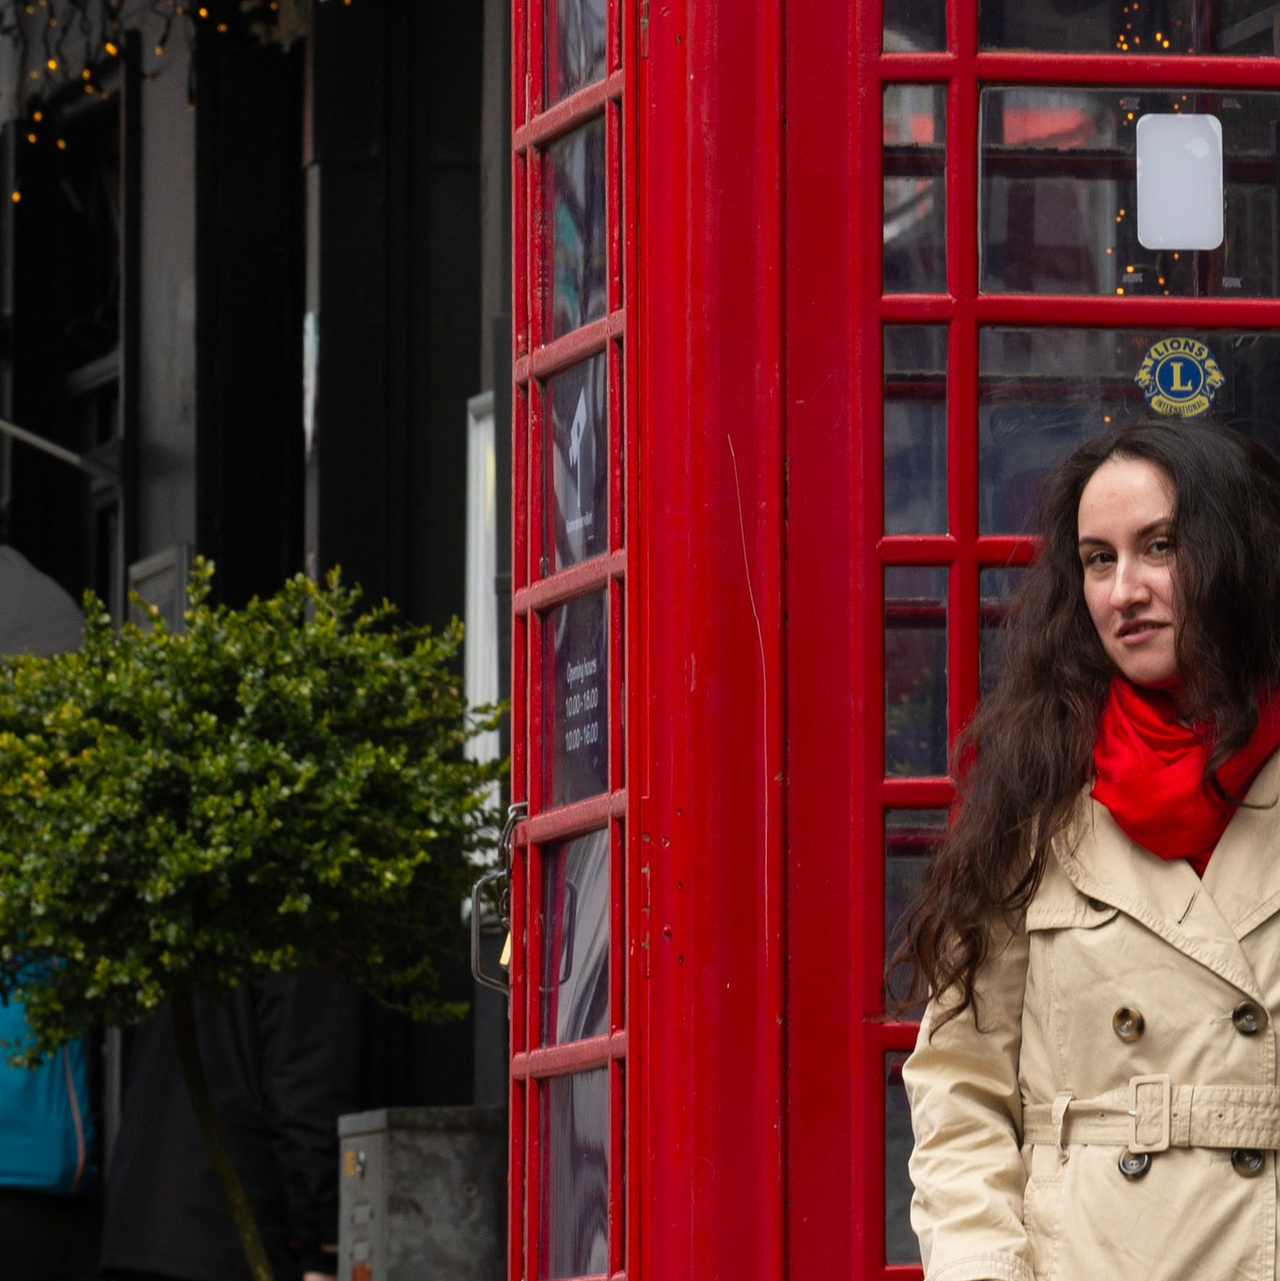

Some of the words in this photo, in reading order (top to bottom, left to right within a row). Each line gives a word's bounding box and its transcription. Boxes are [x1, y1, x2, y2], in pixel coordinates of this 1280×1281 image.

[1154, 339, 1206, 357] LIONS
[1170, 361, 1193, 392] L
[1155, 399, 1206, 414] INTERNATIONAL
[566, 660, 584, 690] Opening
[584, 657, 598, 677] hours
